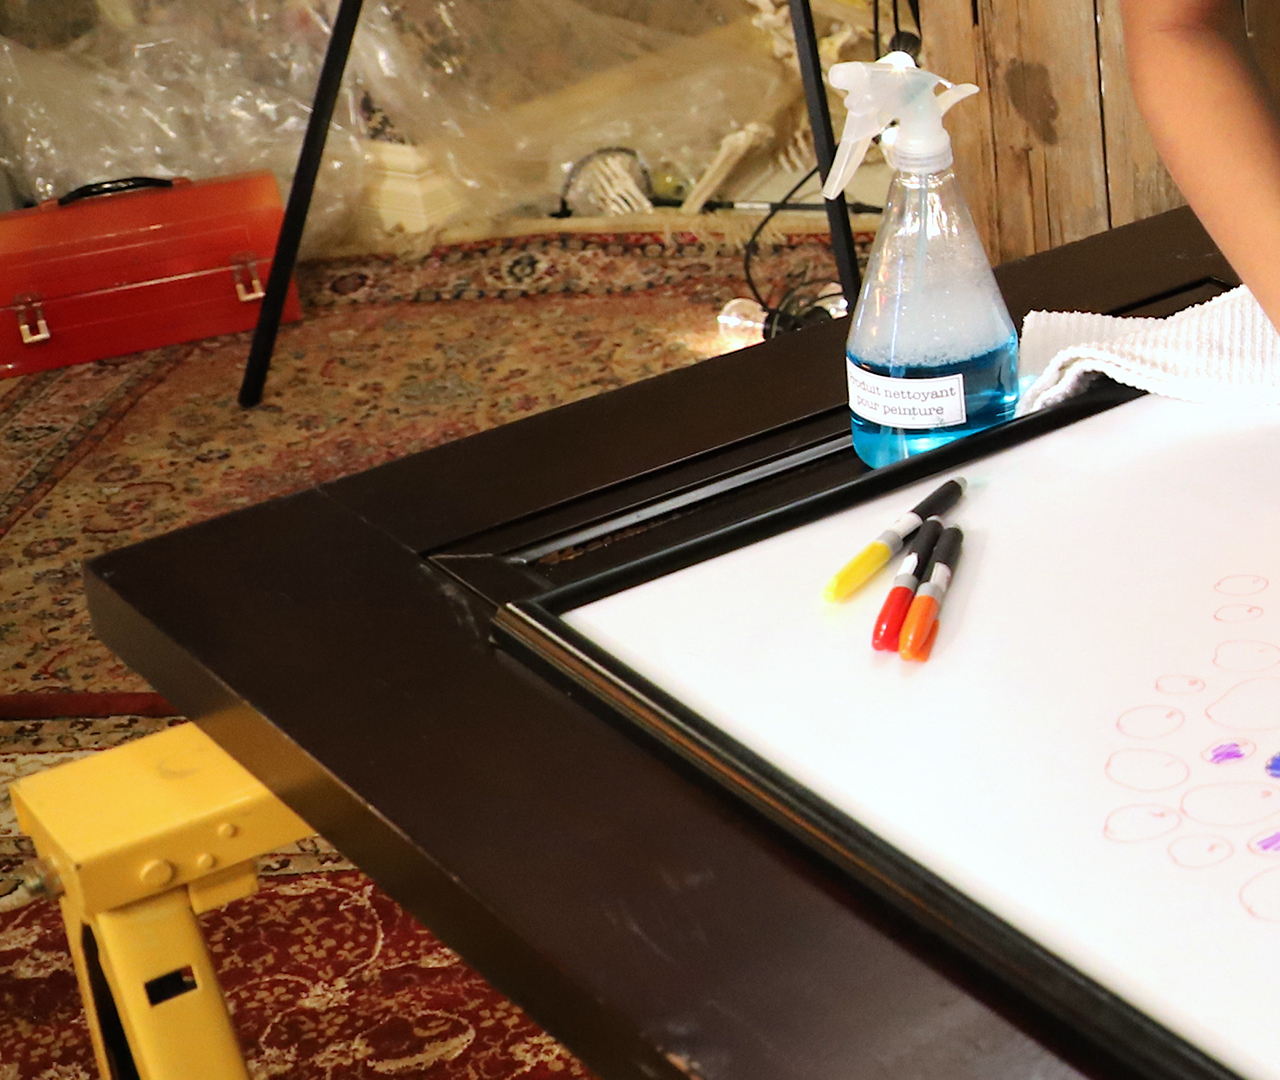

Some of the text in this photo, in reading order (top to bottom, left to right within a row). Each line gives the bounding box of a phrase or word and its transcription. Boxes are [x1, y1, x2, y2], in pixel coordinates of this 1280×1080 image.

[884, 386, 956, 402] nettoyant
[857, 395, 944, 416] pour peinture
